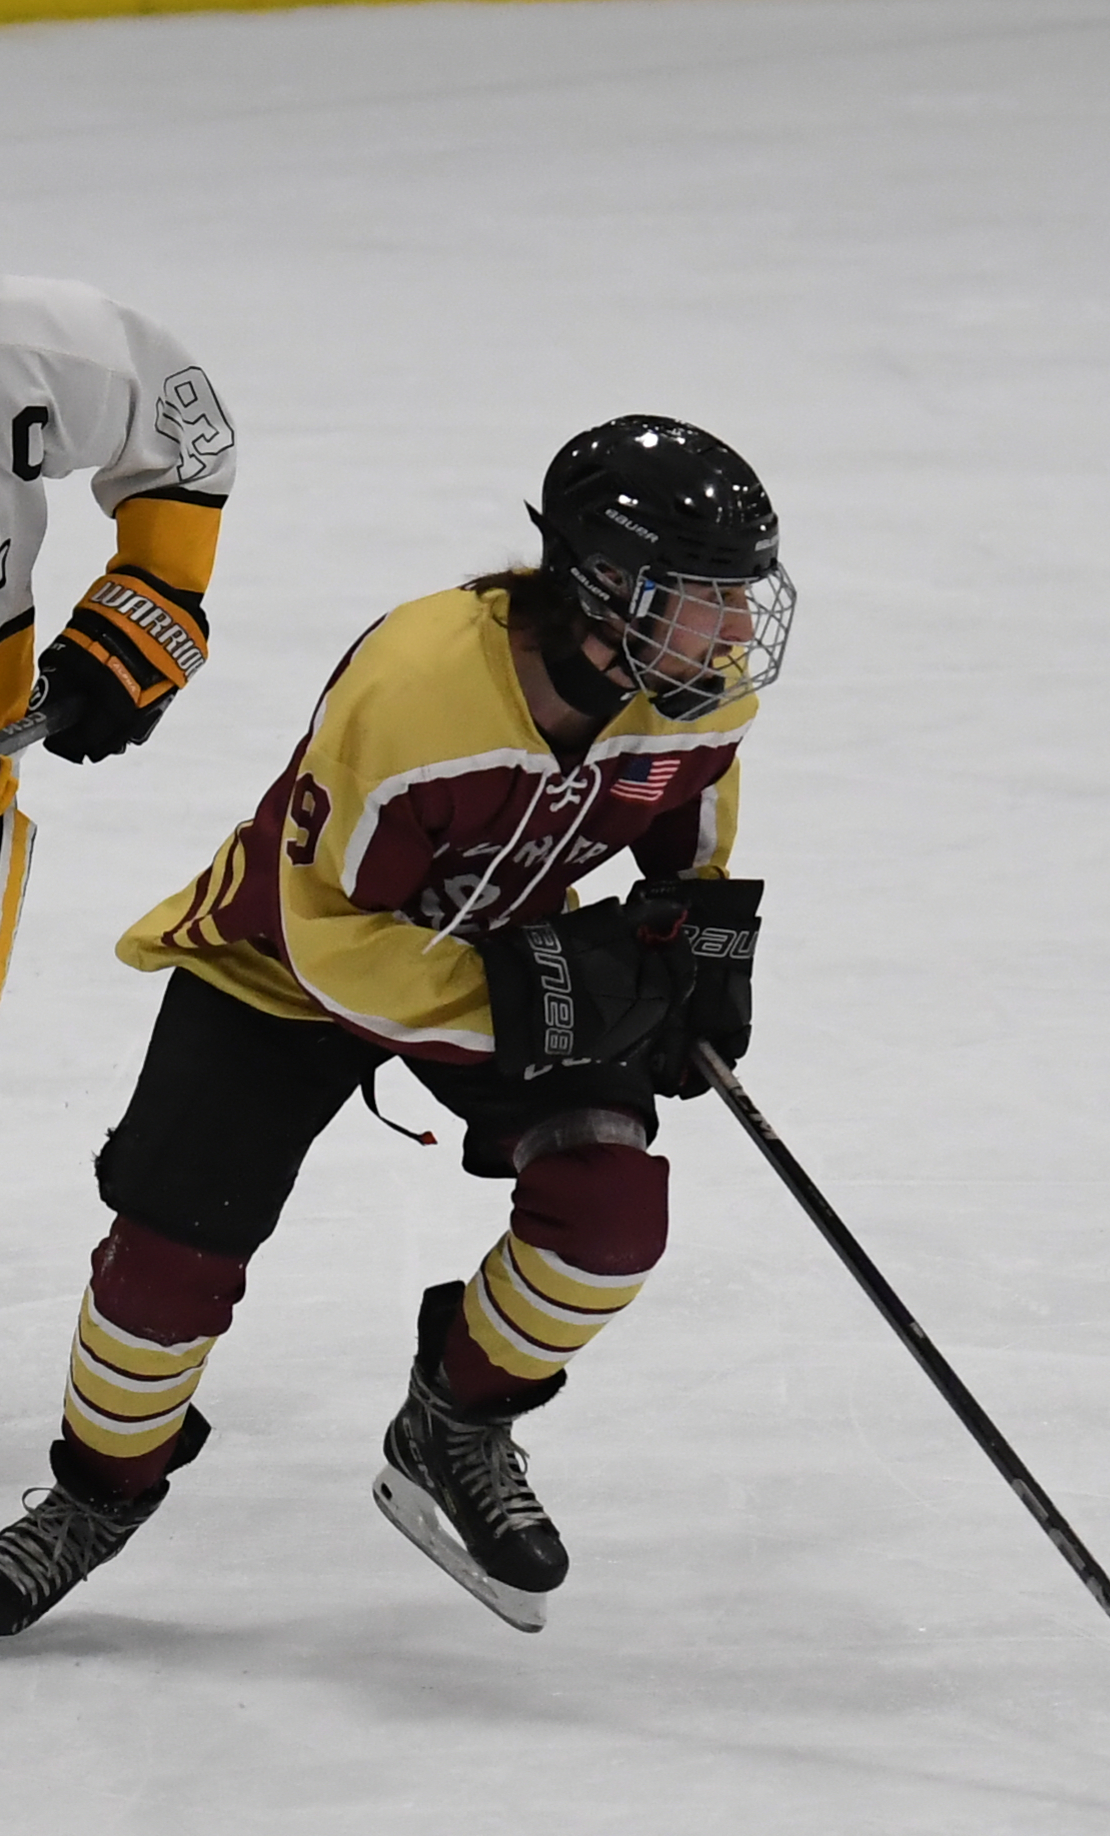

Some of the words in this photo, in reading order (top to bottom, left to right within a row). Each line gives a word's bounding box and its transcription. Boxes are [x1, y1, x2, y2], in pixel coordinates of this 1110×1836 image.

[11, 405, 49, 482] C
[155, 365, 235, 483] 19
[604, 508, 659, 543] BAUER
[112, 662, 138, 692] ALPHA
[284, 769, 333, 867] 9
